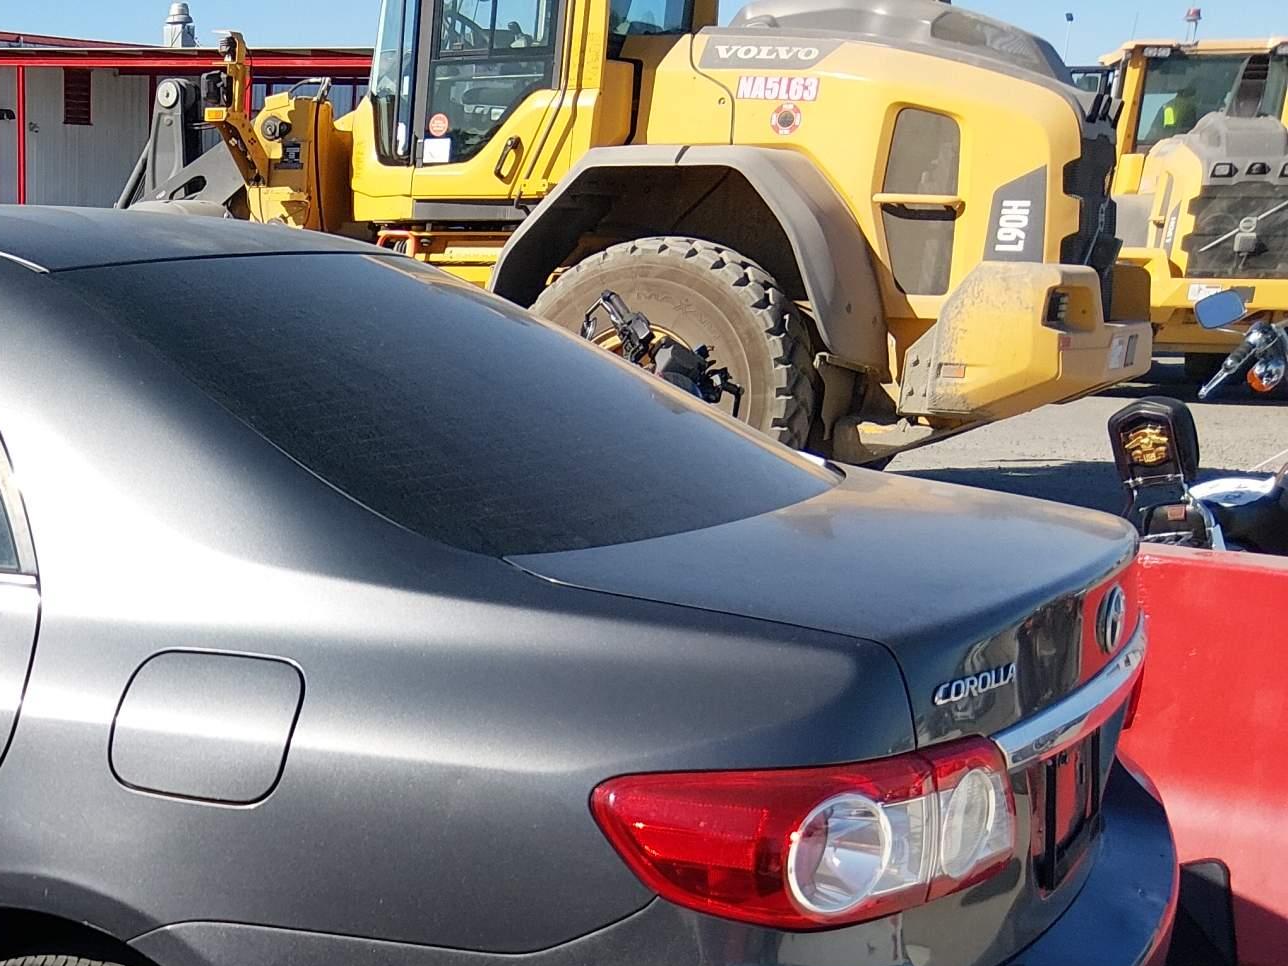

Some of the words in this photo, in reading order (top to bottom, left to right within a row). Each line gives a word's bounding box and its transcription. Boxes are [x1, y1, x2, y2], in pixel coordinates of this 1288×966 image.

[713, 45, 820, 60] VOLVO
[995, 200, 1032, 252] L90H
[934, 662, 1017, 706] COROLLA
